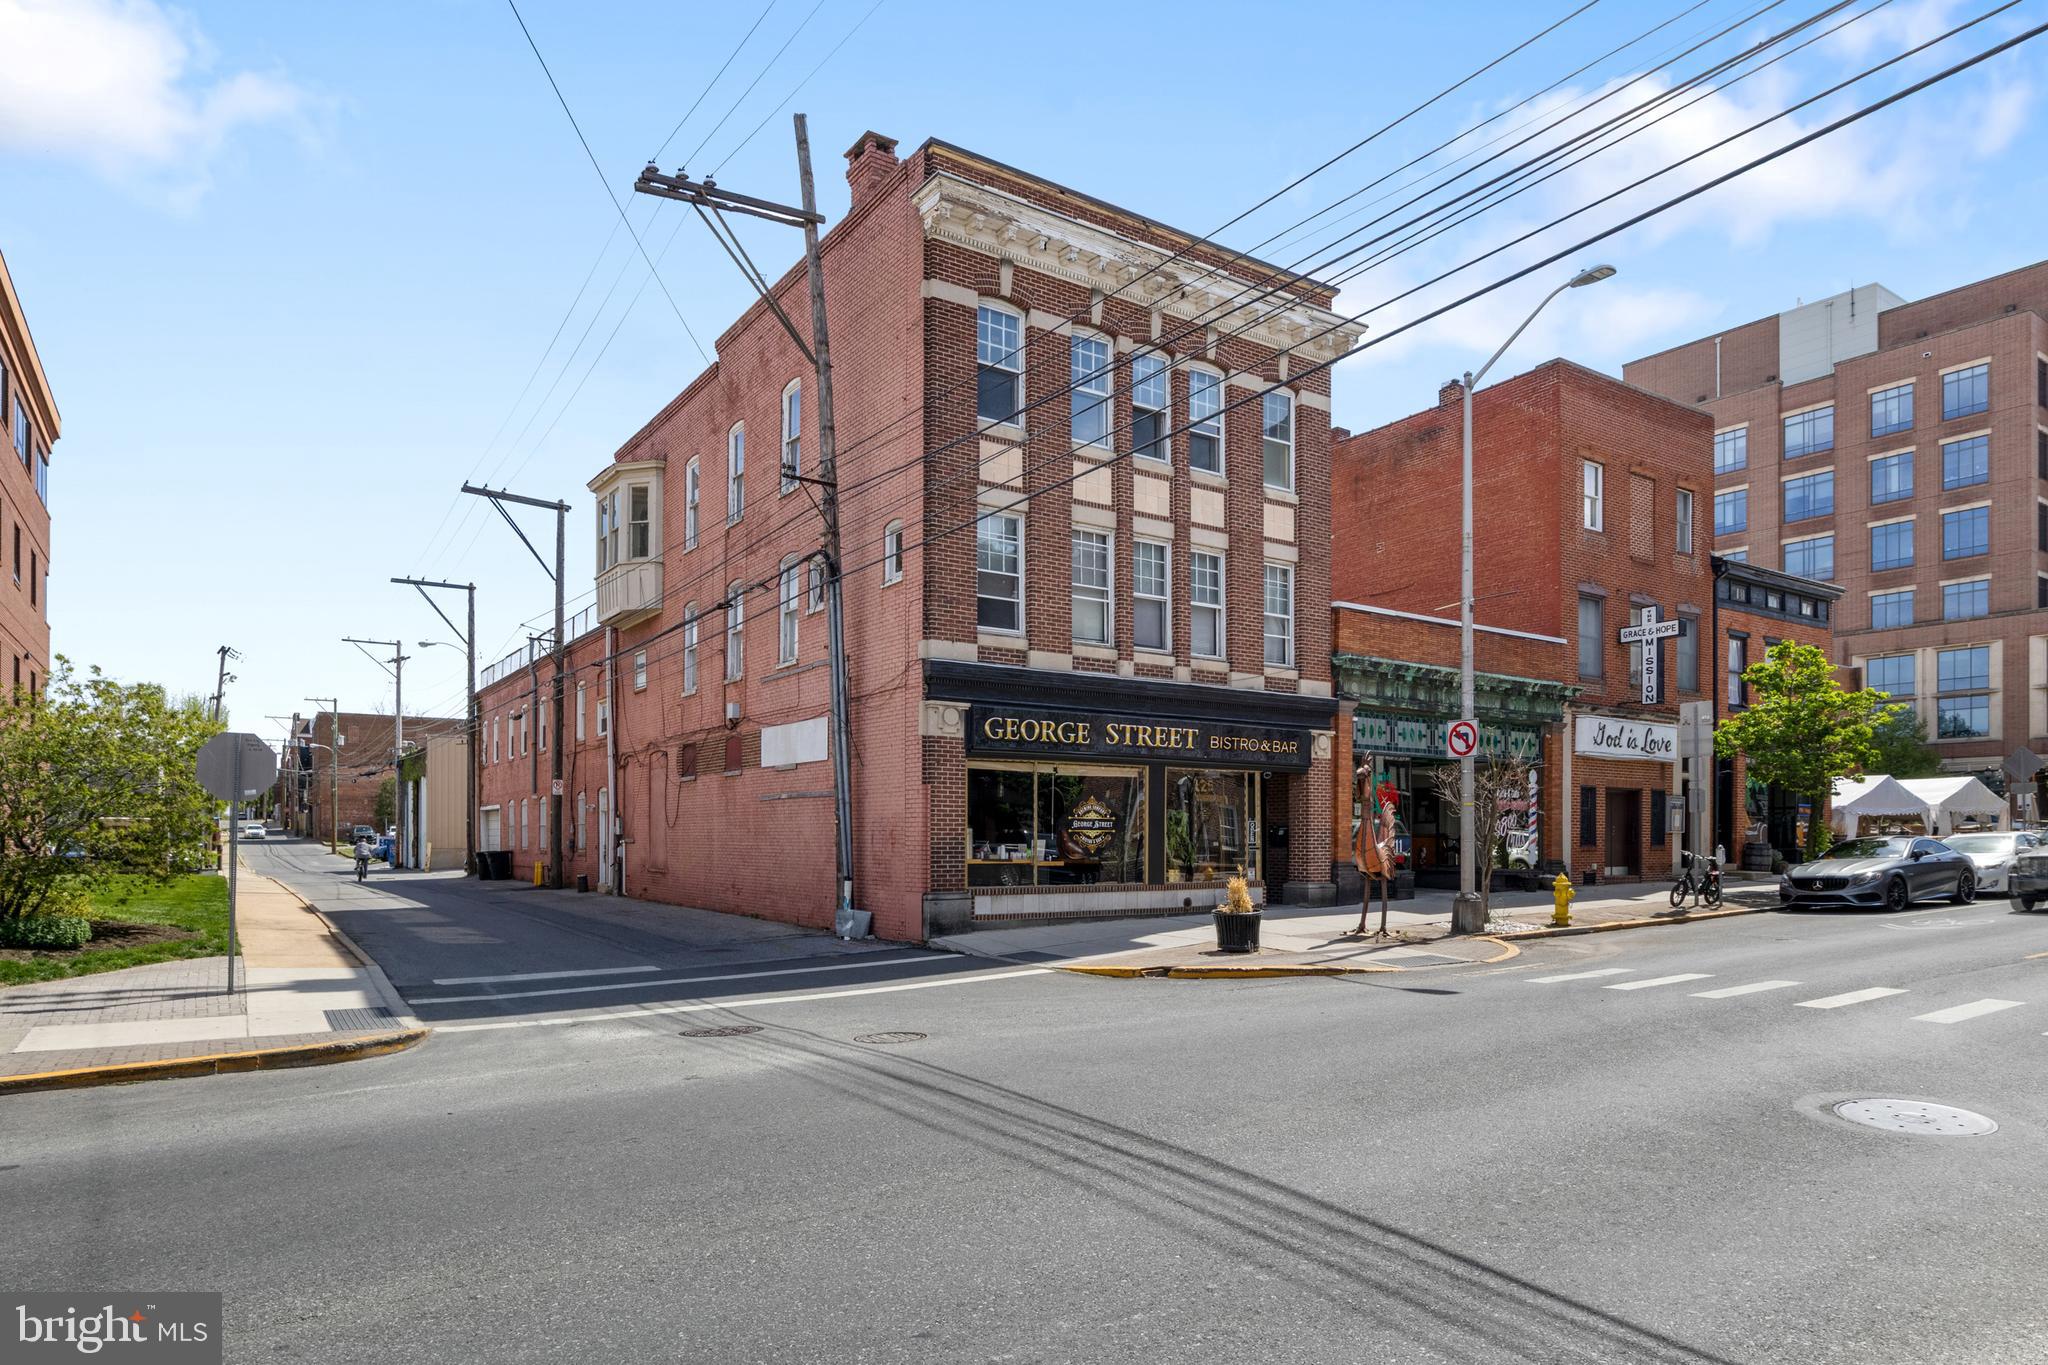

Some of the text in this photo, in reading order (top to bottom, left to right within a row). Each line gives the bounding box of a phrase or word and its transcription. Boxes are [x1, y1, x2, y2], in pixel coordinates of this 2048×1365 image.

[1623, 624, 1677, 639] GRACE & HOPE
[1645, 638, 1654, 702] MISSION
[984, 716, 1091, 745] GEORGE
[1105, 723, 1199, 750] STREET
[1593, 721, 1672, 755] God is Love
[1092, 820, 1113, 829] STREET
